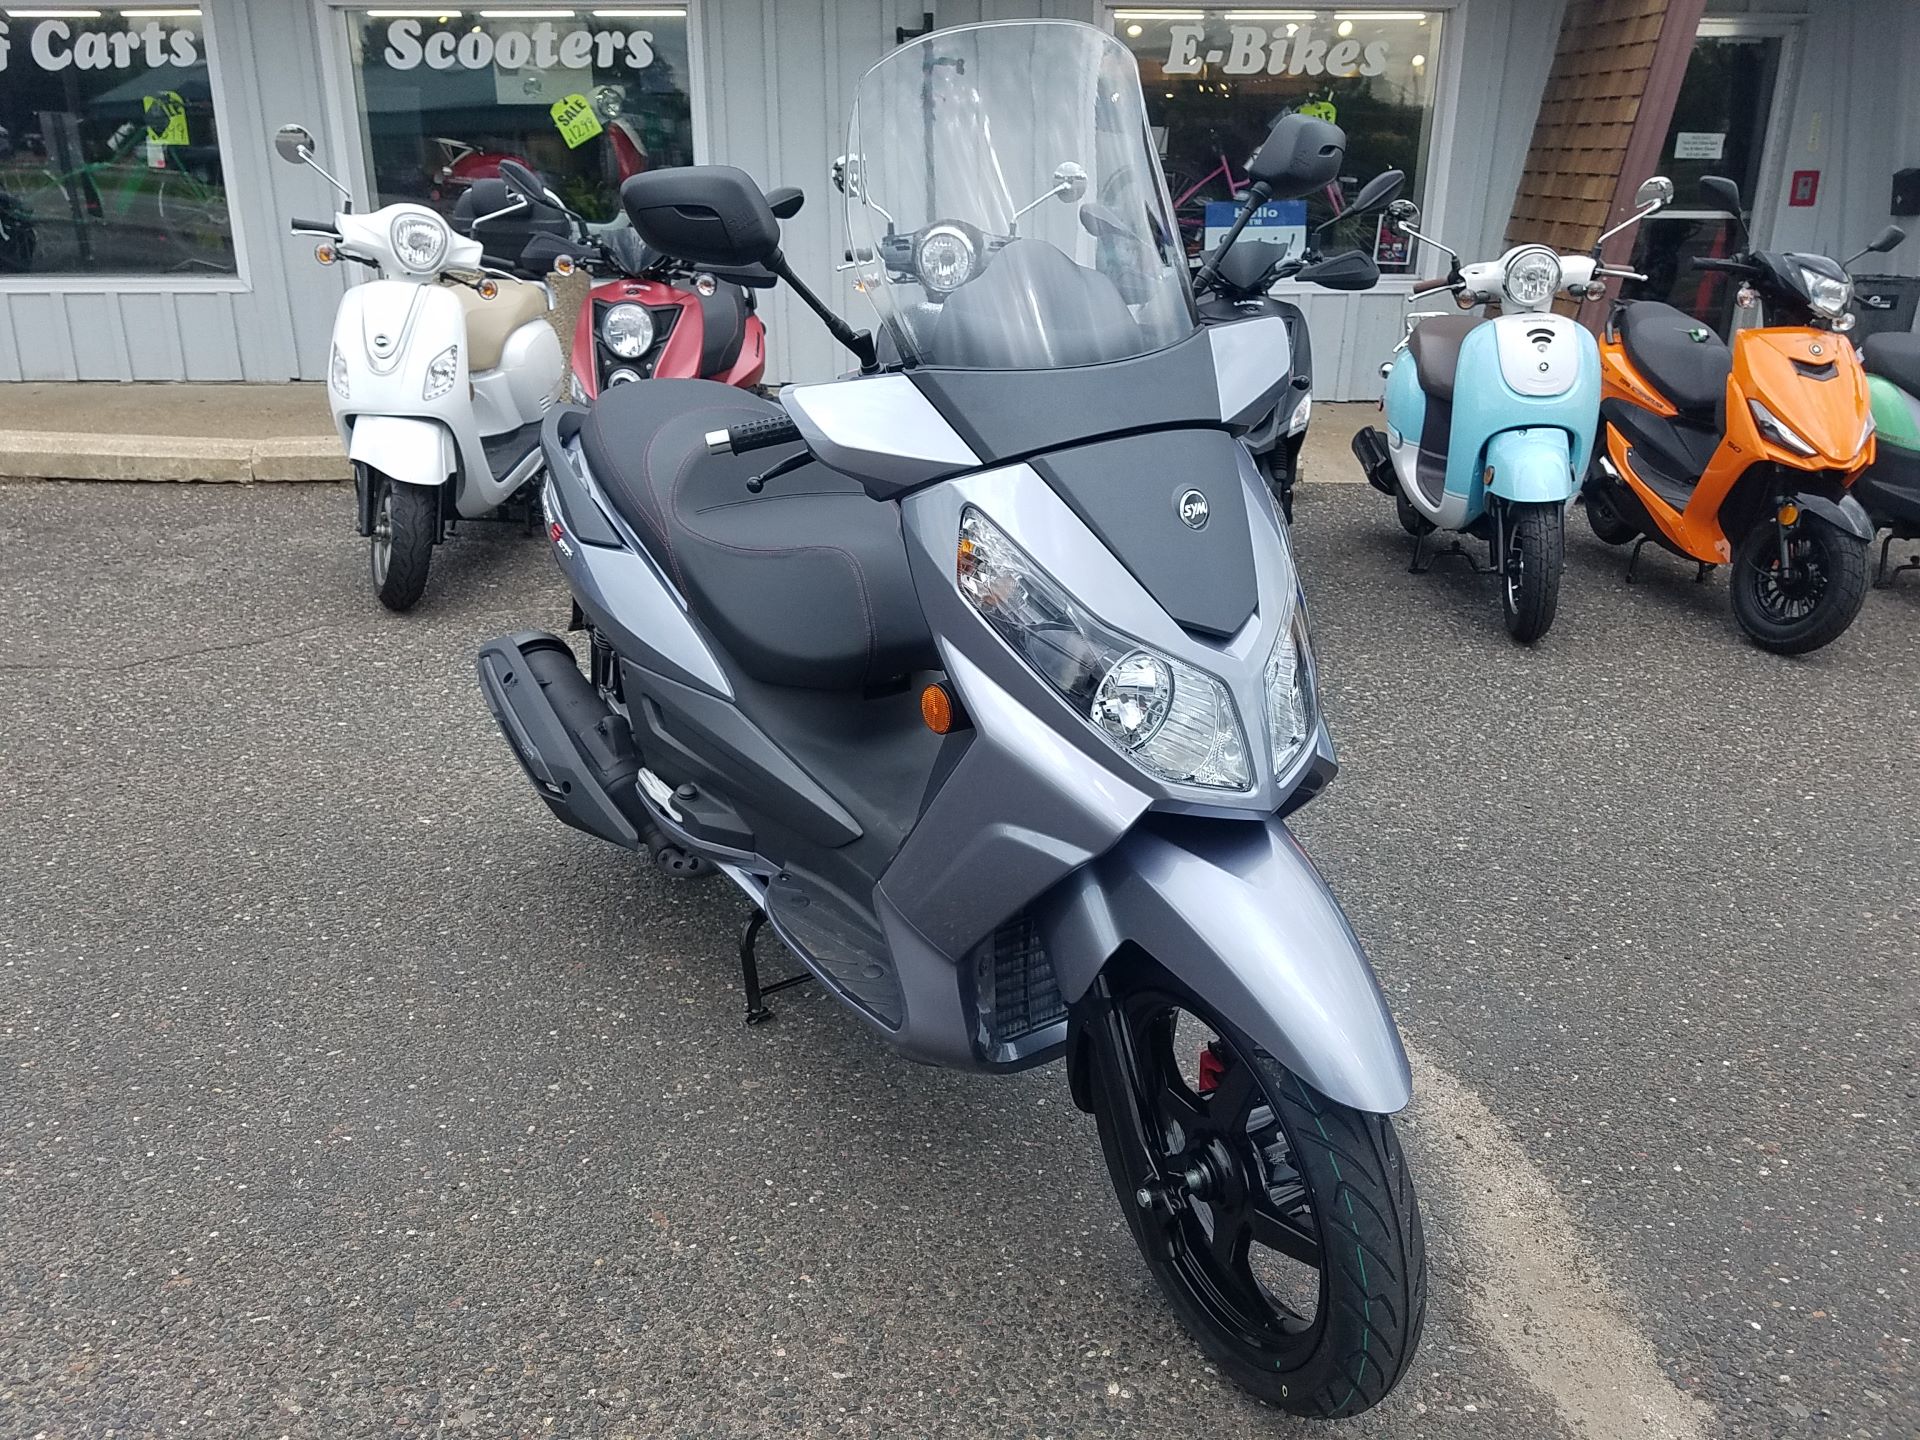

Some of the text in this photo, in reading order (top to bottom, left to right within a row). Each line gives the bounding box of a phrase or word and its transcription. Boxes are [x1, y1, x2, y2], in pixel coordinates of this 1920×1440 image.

[31, 20, 197, 71] Carts
[384, 19, 654, 70] Scooters
[1162, 25, 1389, 77] E-Bikes
[557, 99, 587, 127] SALE
[1184, 502, 1207, 519] SYM
